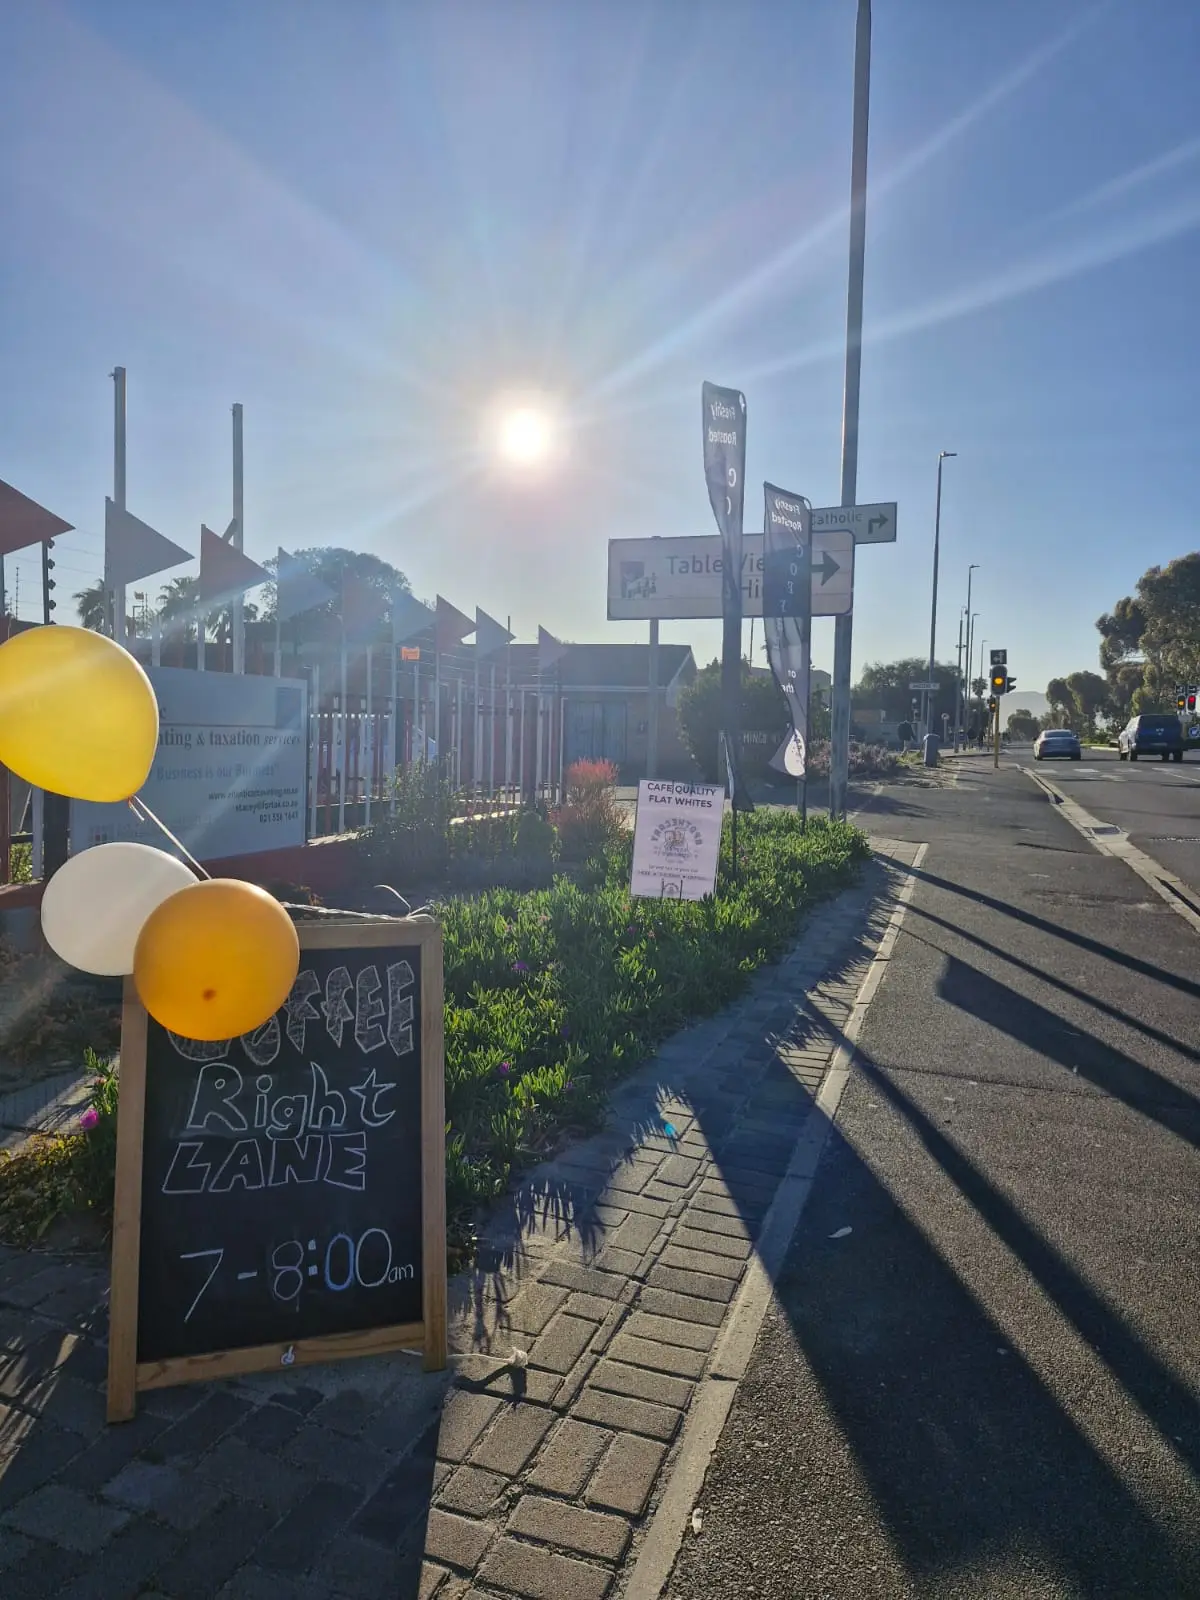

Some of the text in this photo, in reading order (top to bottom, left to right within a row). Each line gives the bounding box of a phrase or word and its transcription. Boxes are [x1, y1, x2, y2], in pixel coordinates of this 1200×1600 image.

[667, 555, 723, 575] Table
[196, 734, 205, 747] &
[209, 730, 260, 747] taxation
[647, 782, 717, 797] CAFE QUALITY
[648, 794, 713, 808] FLAT WHITES
[167, 960, 415, 1066] FFEE
[186, 1061, 397, 1140] Right
[161, 1131, 368, 1194] LANE
[180, 1247, 225, 1324] 7
